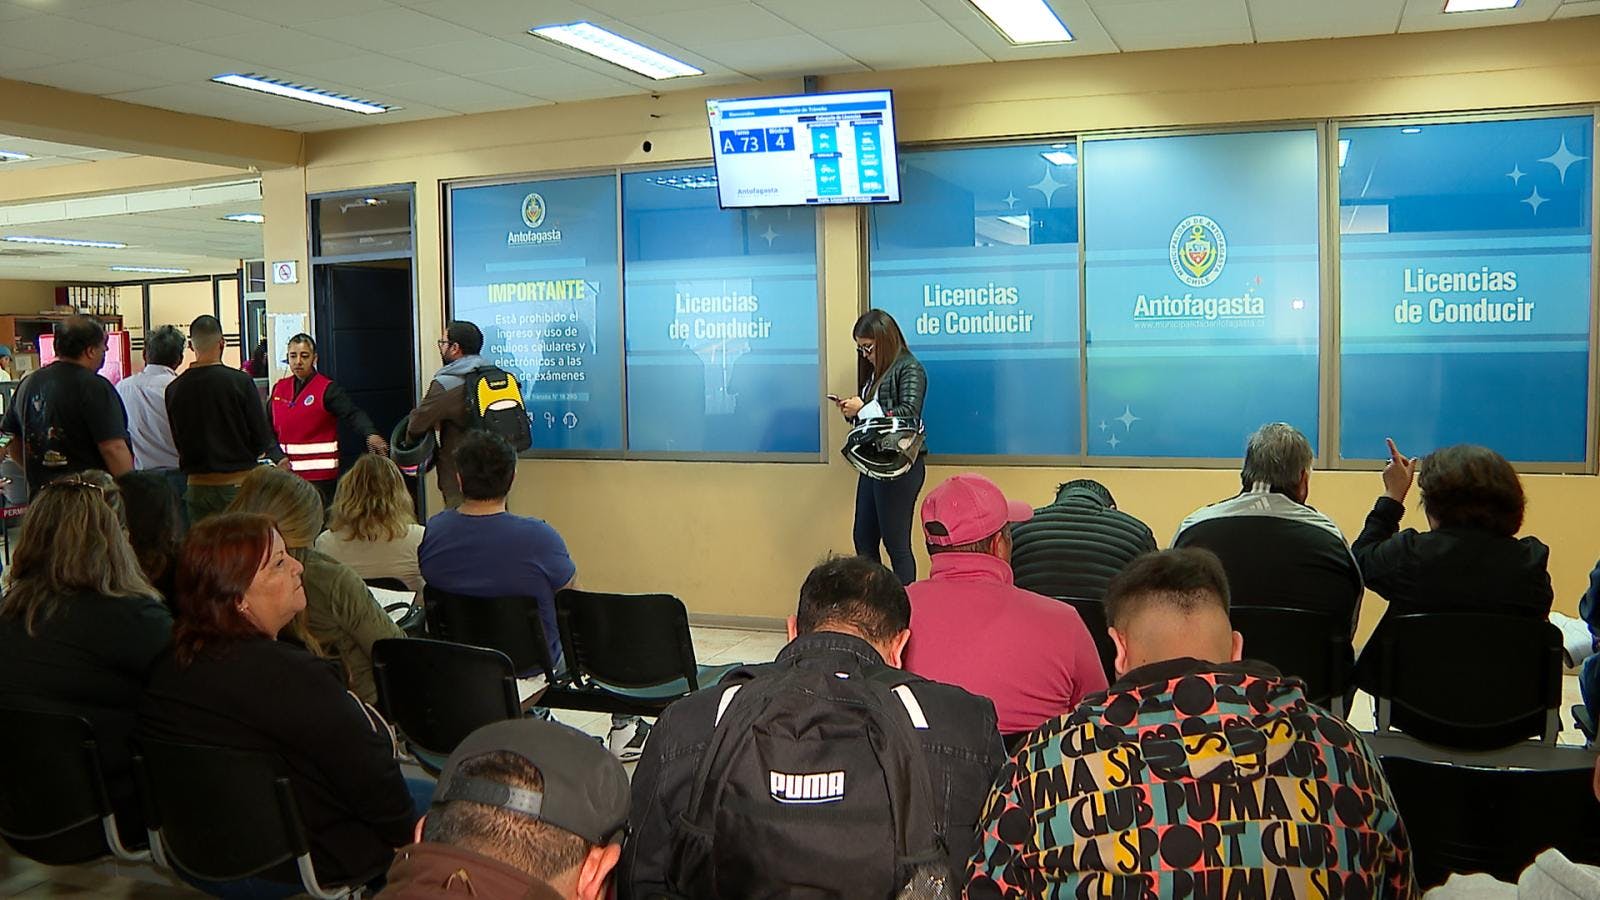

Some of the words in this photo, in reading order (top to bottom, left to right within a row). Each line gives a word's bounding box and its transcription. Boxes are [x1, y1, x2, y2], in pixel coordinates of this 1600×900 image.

[723, 138, 735, 152] A
[740, 137, 759, 152] 73
[775, 134, 785, 149] 4
[508, 229, 561, 244] Antofagasta
[1206, 221, 1225, 273] ANTOFAGASTA
[1186, 277, 1211, 286] CHILE
[1404, 266, 1517, 292] Licencias
[488, 279, 585, 304] IMPORTANTE
[675, 292, 759, 313] Licencias
[924, 282, 1018, 307] Licencias
[1133, 293, 1265, 320] Antofagasta
[1394, 299, 1423, 323] de
[1429, 297, 1534, 323] Conducir
[496, 313, 517, 324] Está
[520, 312, 567, 326] prohibido
[570, 312, 579, 322] el
[669, 319, 689, 339] de
[694, 317, 772, 339] Conducir
[916, 312, 940, 334] de
[945, 310, 1033, 333] Conducir
[497, 329, 533, 339] ingreso
[535, 329, 542, 340] y
[544, 329, 562, 337] uso
[565, 326, 578, 336] de
[491, 343, 529, 354] equipos
[531, 342, 577, 352] celulares
[579, 342, 586, 354] y
[495, 356, 556, 368] electrónicos
[558, 358, 565, 367] a
[567, 356, 582, 366] las
[519, 371, 532, 382] de
[535, 371, 585, 382] exámenes
[770, 771, 845, 799] PUMA
[1070, 785, 1154, 838] CLUB
[1164, 778, 1293, 825] PUMA
[1117, 821, 1246, 873] SPORT
[1261, 821, 1338, 868] CLUB
[1075, 872, 1159, 900] CLUB
[1172, 867, 1297, 900] PUMA
